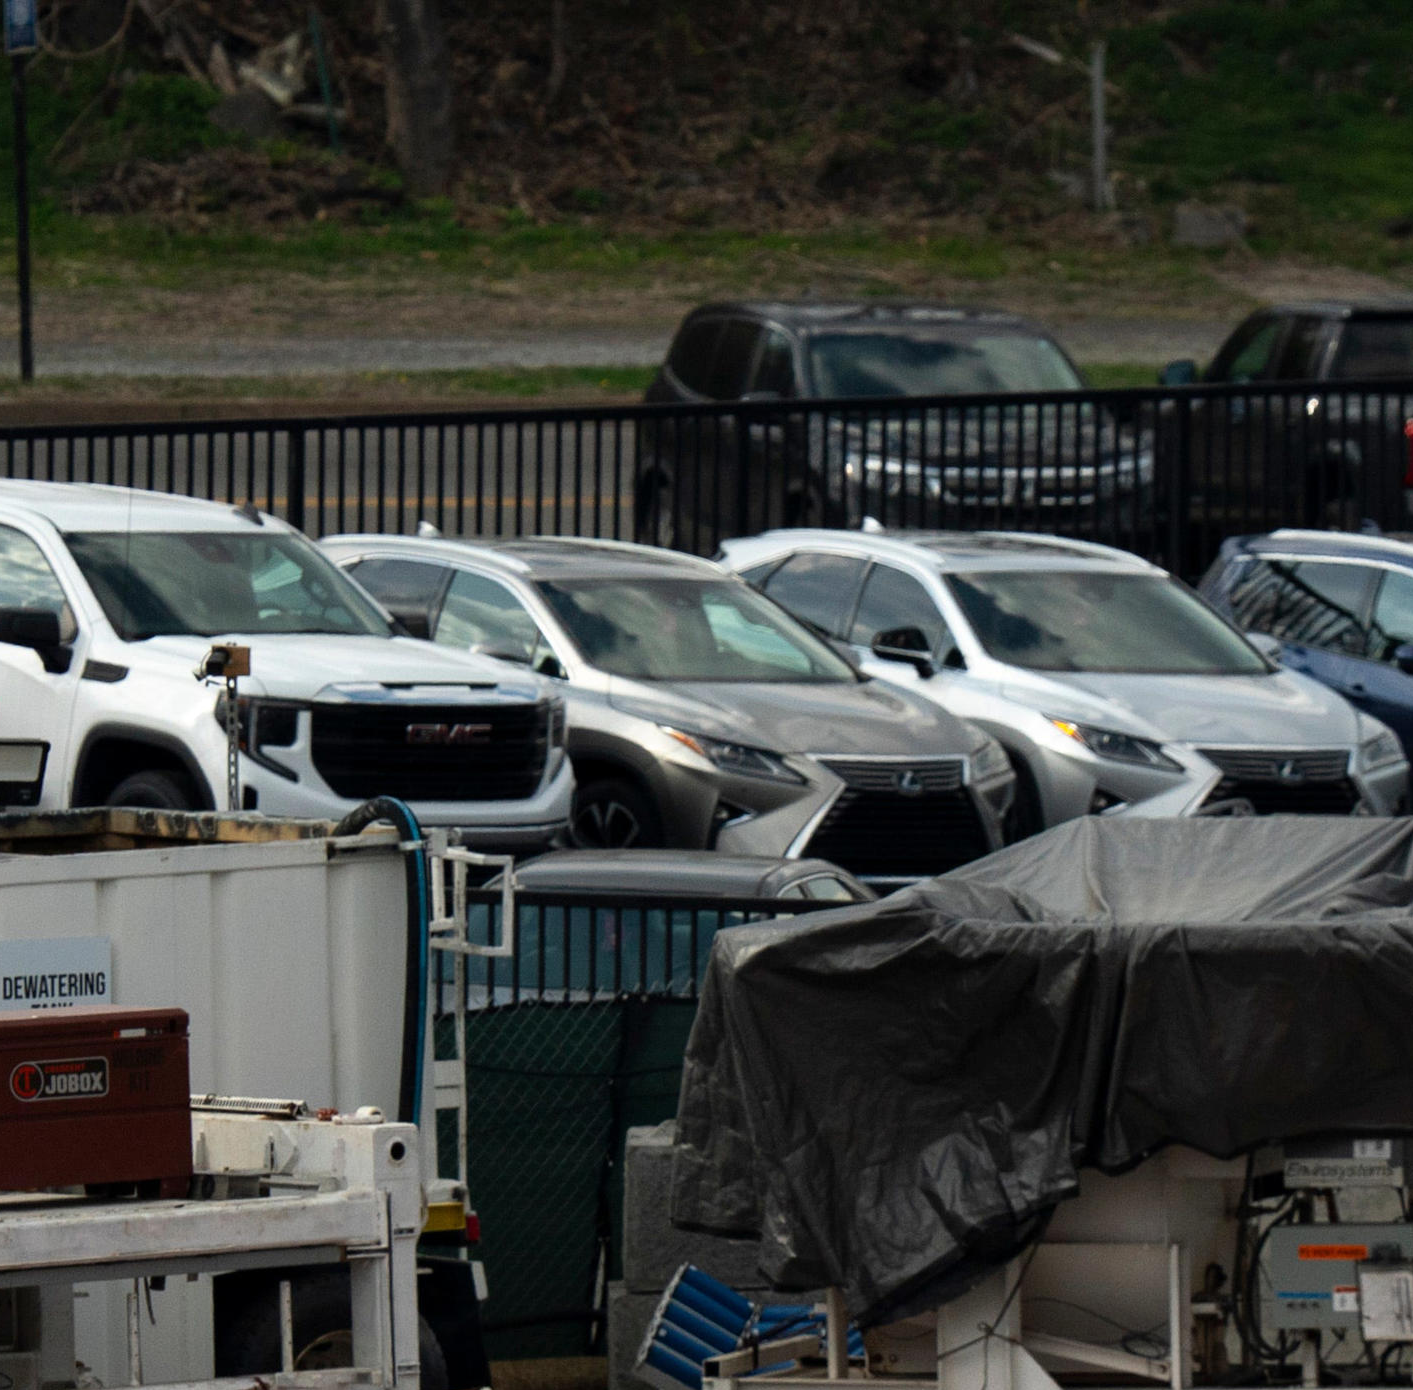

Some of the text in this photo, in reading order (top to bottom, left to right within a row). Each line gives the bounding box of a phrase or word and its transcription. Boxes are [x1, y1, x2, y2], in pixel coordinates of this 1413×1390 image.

[406, 723, 492, 745] GMC
[2, 972, 106, 1000] DEWATERING
[45, 1072, 104, 1094] JOBOX
